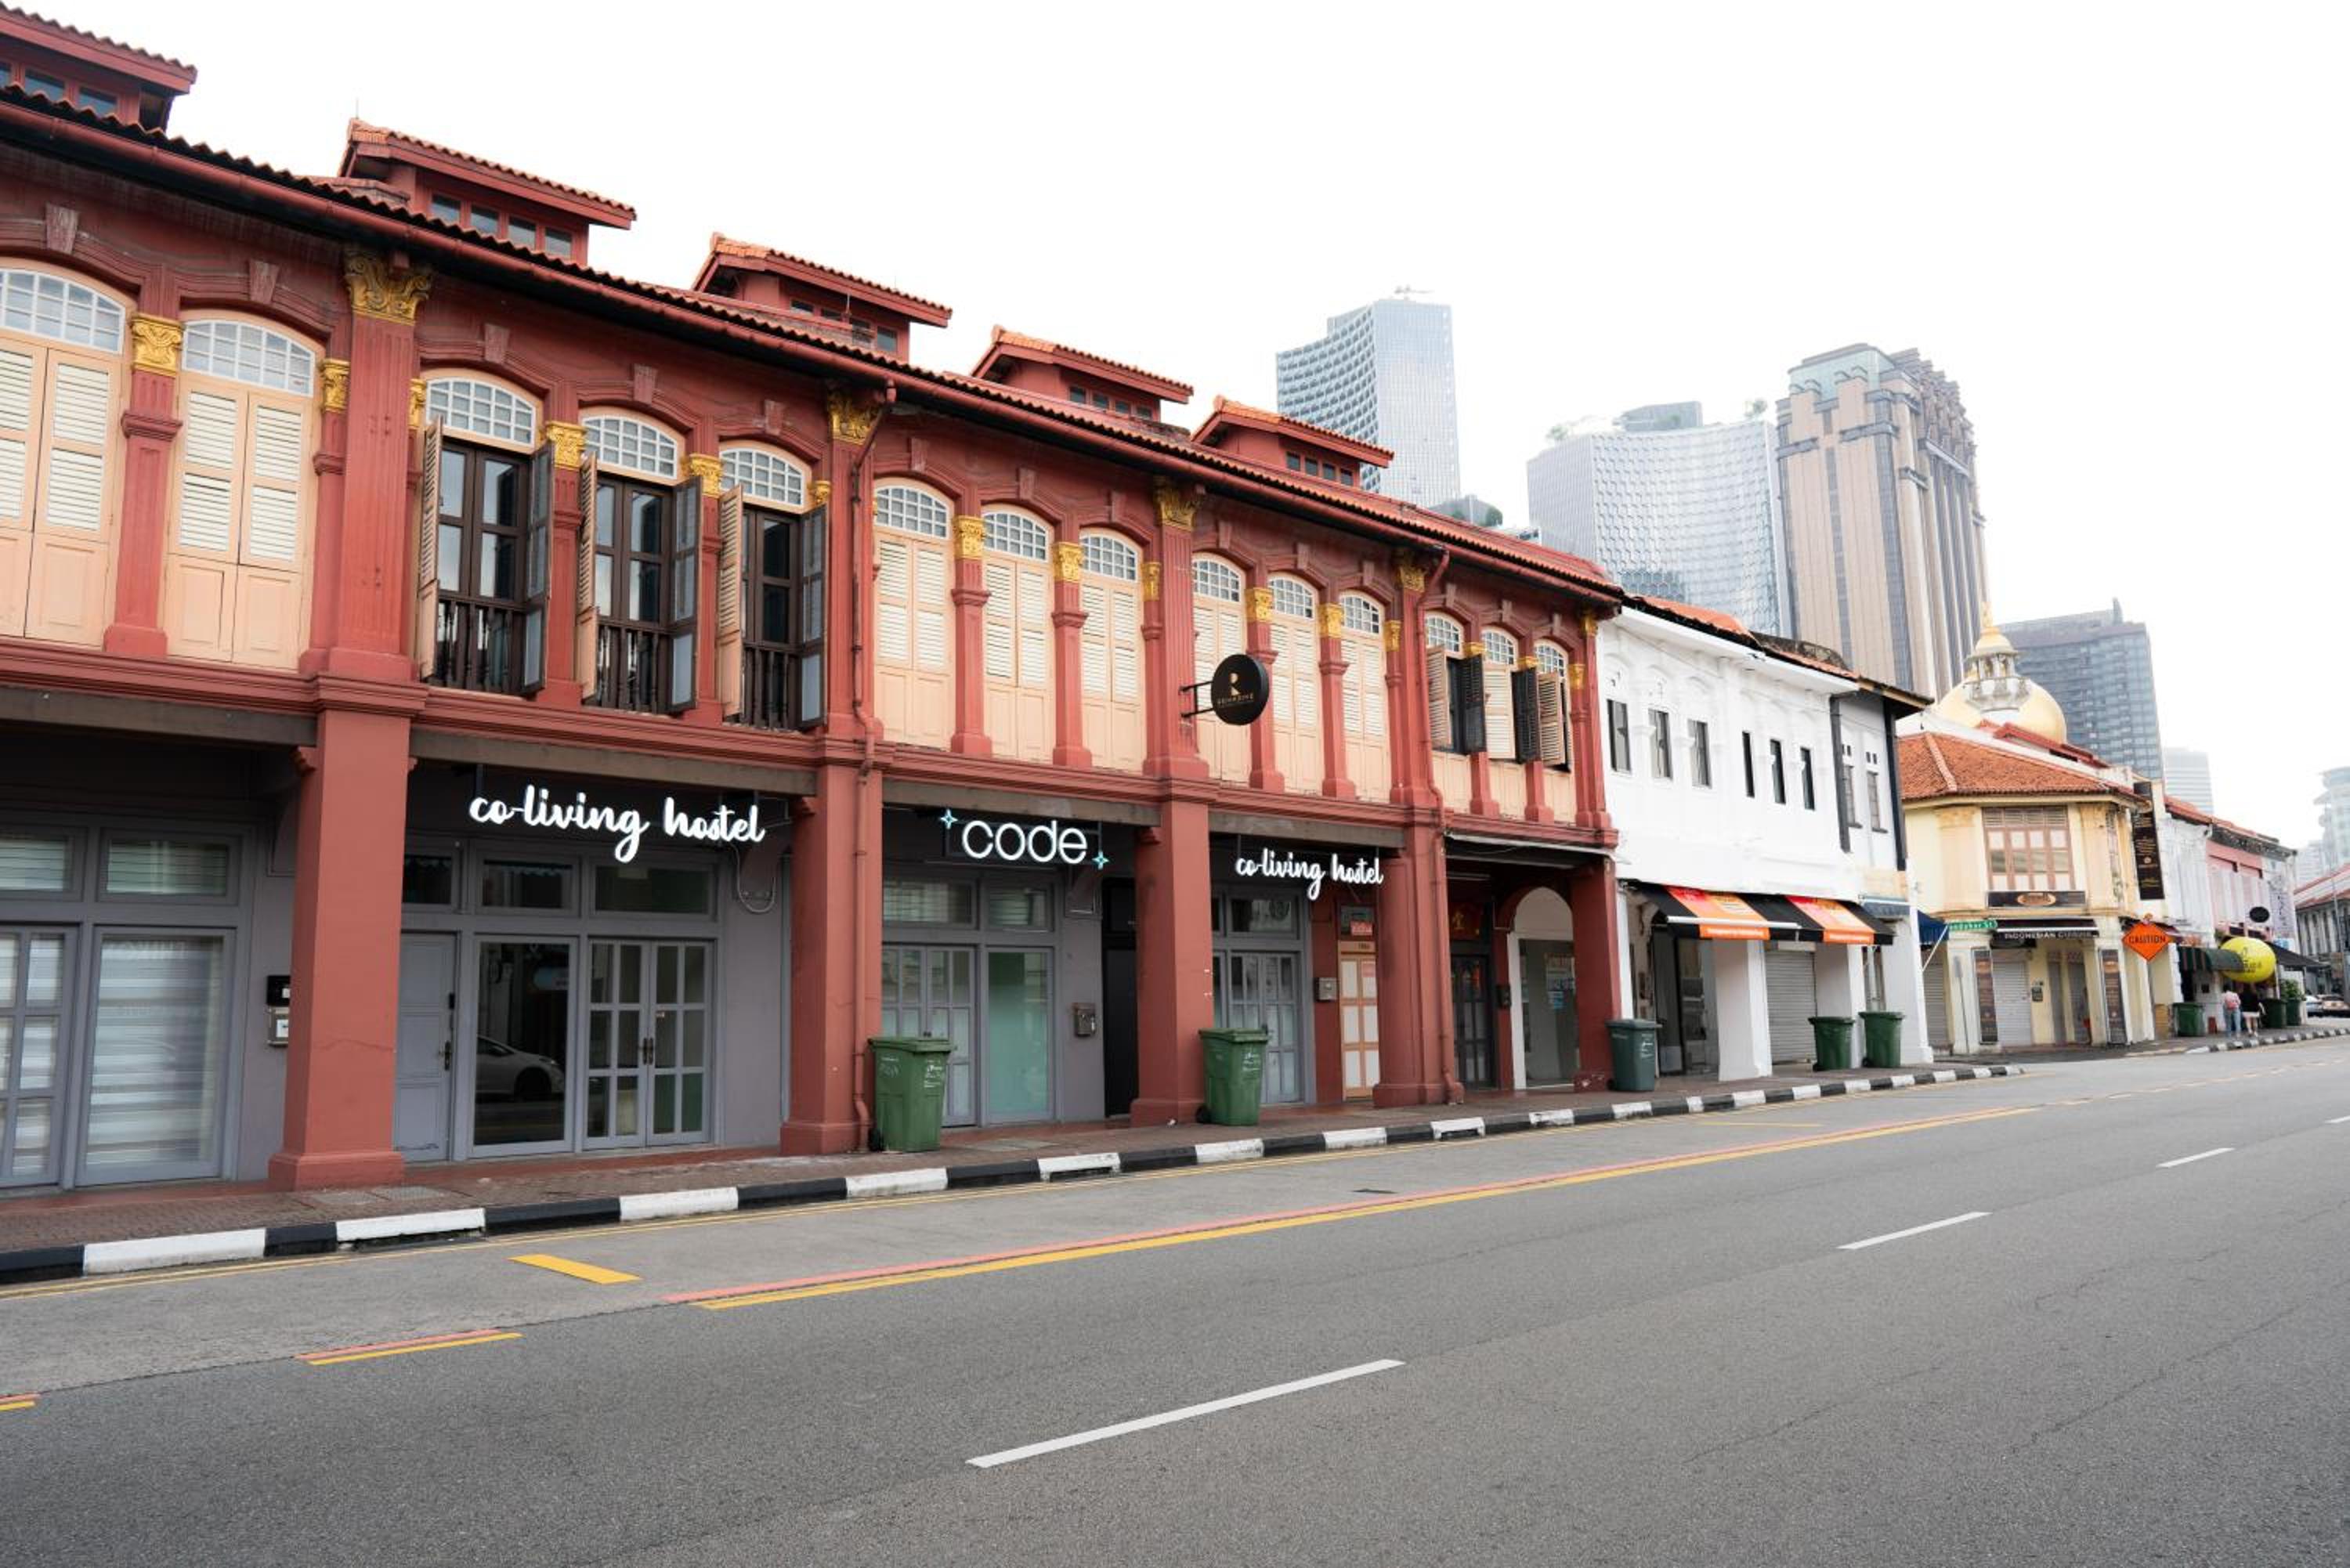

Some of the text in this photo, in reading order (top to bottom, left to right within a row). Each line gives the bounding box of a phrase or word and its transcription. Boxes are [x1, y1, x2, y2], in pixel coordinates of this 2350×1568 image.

[469, 785, 765, 863] co-living hostel
[962, 820, 1087, 864] code
[1235, 848, 1384, 901] co-living hostel
[2128, 934, 2167, 944] CAUTION
